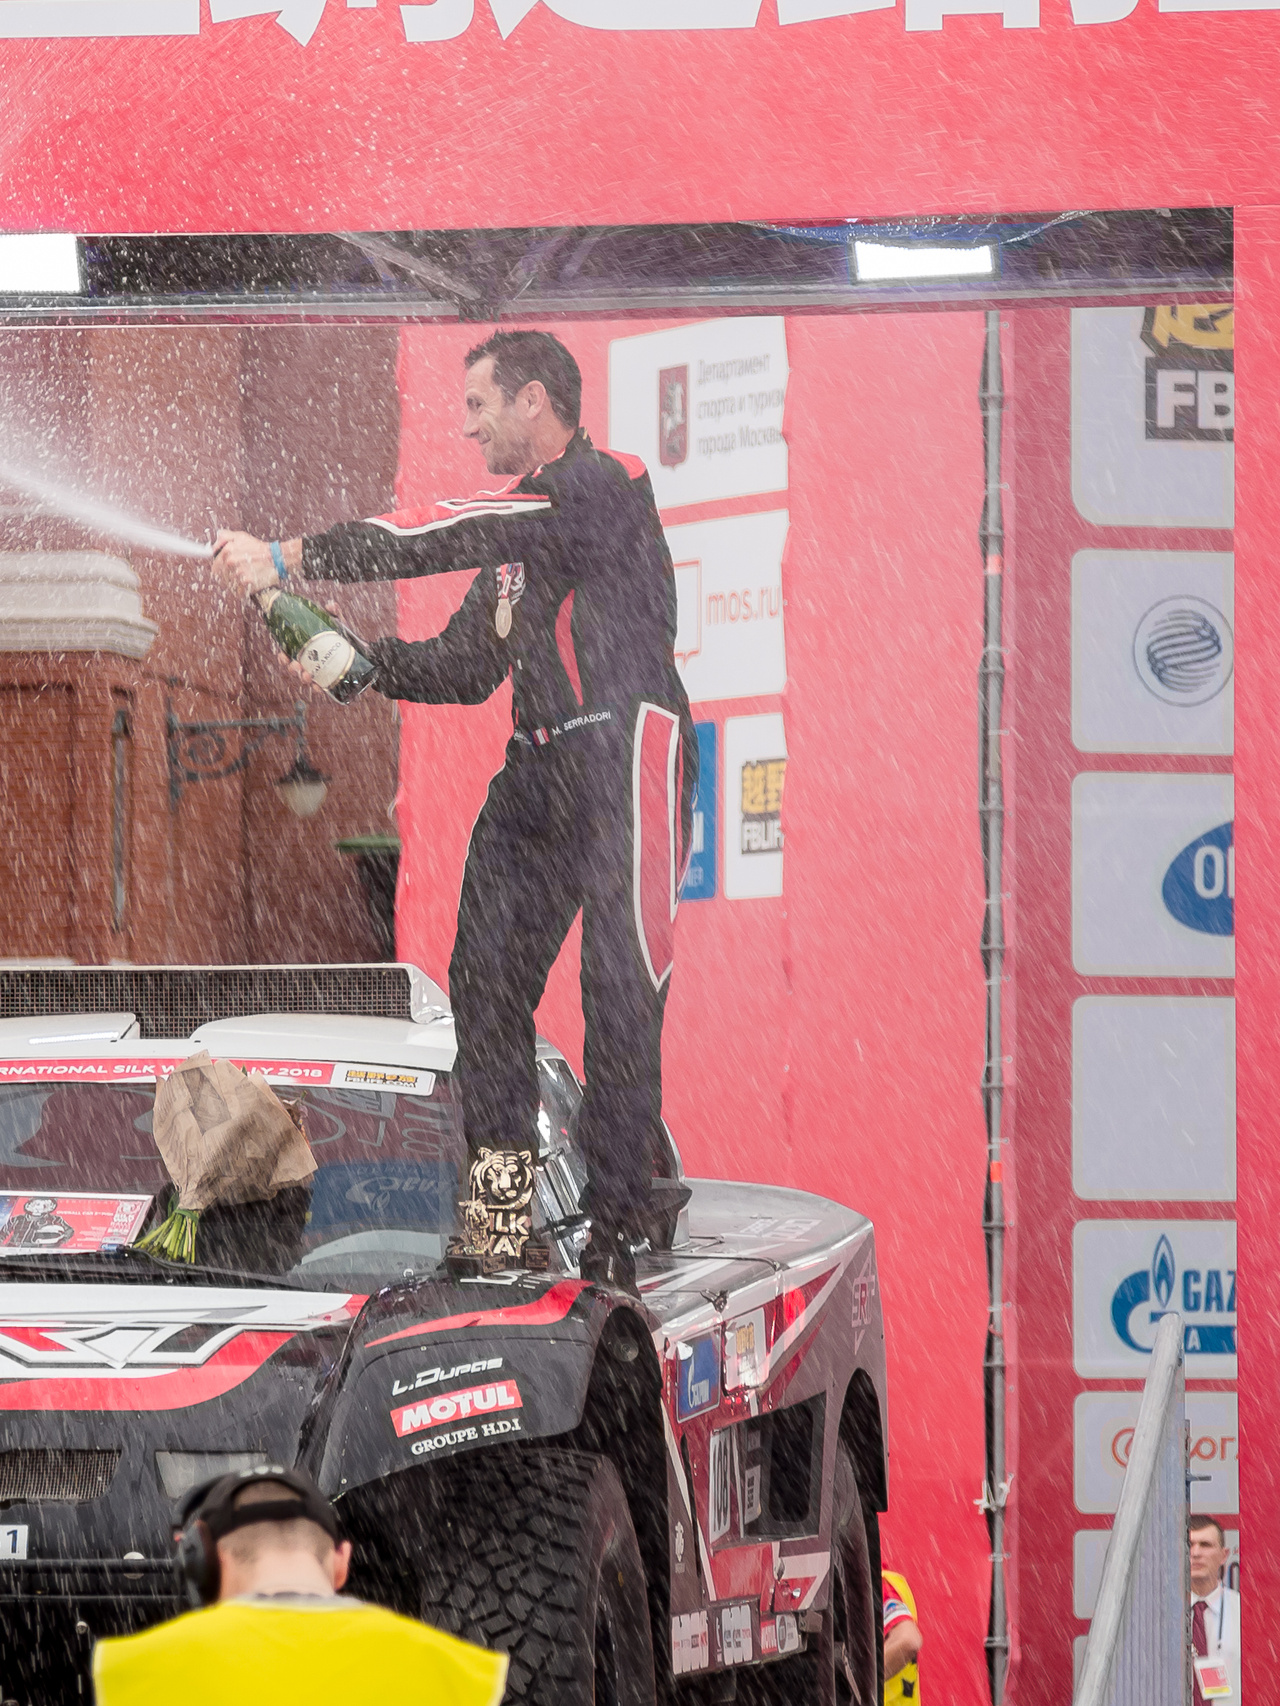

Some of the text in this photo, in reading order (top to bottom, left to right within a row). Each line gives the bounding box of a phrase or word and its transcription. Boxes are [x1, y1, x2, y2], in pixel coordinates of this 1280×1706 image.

[706, 586, 780, 626] mos.ru
[563, 710, 612, 731] SERRADORI
[112, 1064, 156, 1075] SILK
[277, 1066, 323, 1079] 2018
[487, 1211, 532, 1235] ILK
[401, 1385, 515, 1432] MOTUL
[410, 1426, 478, 1456] GROUPE
